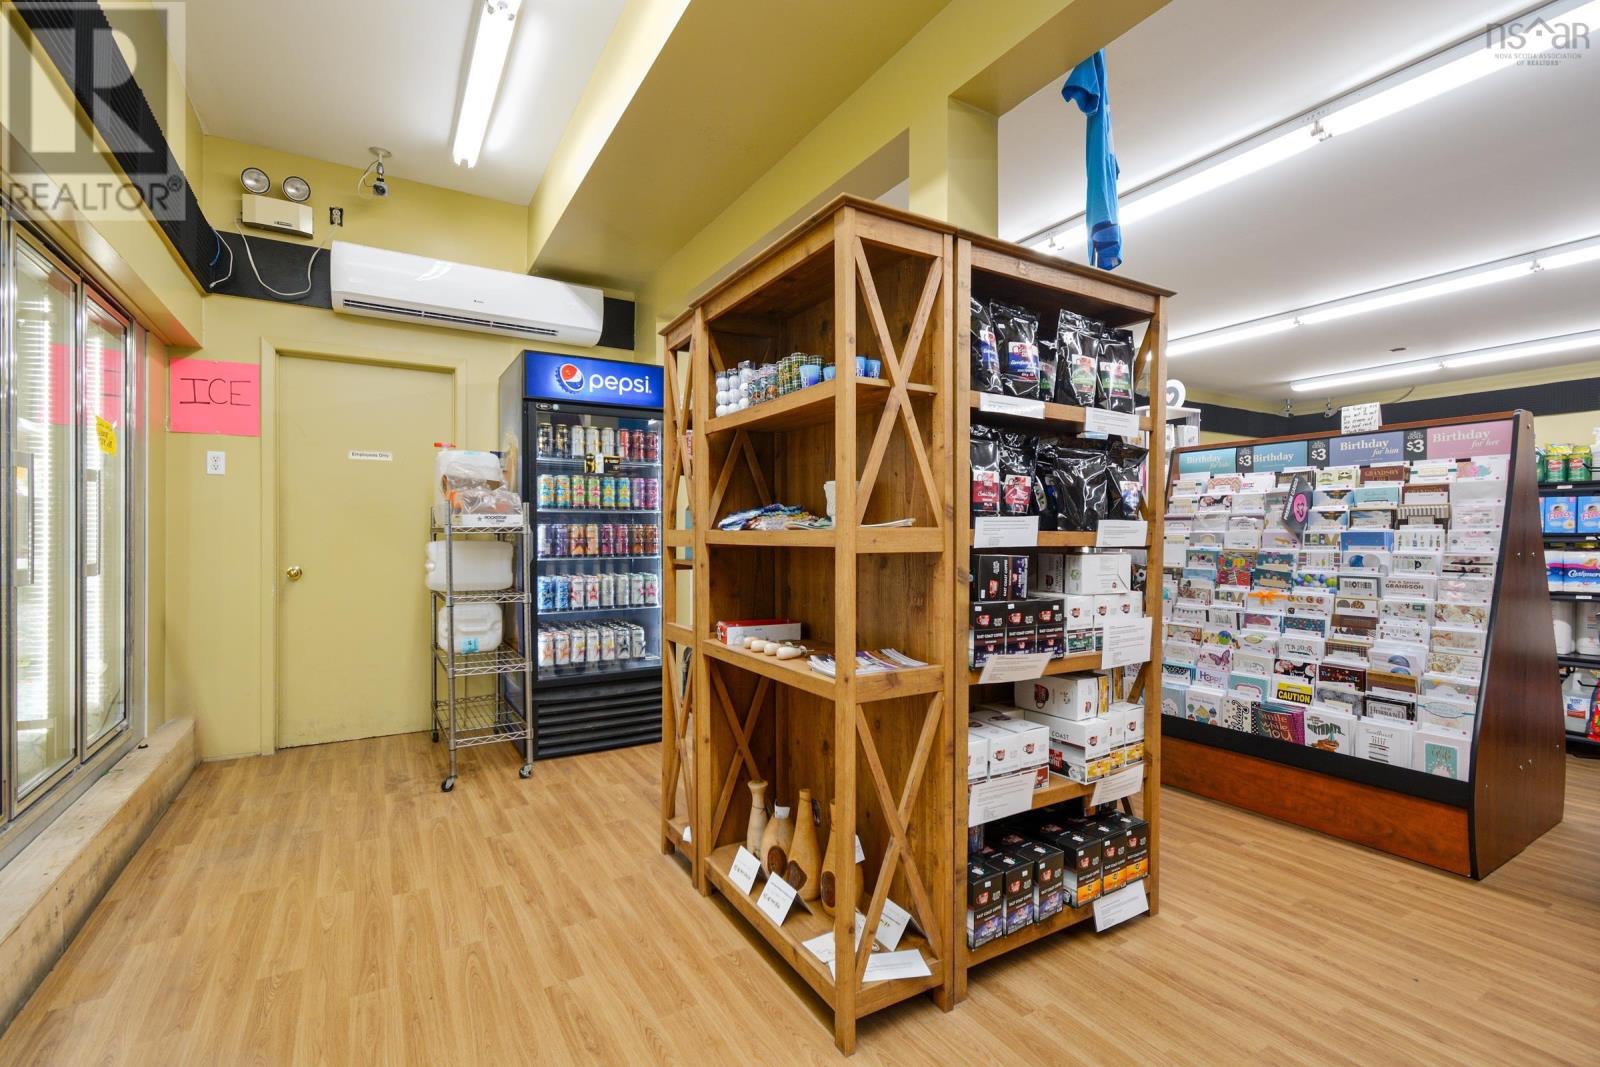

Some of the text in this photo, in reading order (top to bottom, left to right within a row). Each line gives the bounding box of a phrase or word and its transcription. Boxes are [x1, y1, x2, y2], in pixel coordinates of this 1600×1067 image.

[589, 373, 649, 395] pepsi
[180, 378, 251, 406] ICE
[1432, 429, 1491, 443] Birthday
[1340, 439, 1390, 452] Birthday
[1406, 439, 1425, 452] $3
[1471, 438, 1500, 449] for her
[1253, 452, 1295, 464] Birthday
[1311, 448, 1327, 461] $3
[1372, 448, 1384, 458] for
[1186, 455, 1222, 465] Birthday
[1238, 455, 1252, 467] $3
[1344, 581, 1373, 589] BROTHER
[1278, 690, 1311, 704] CAUTION
[1051, 730, 1070, 740] COAST
